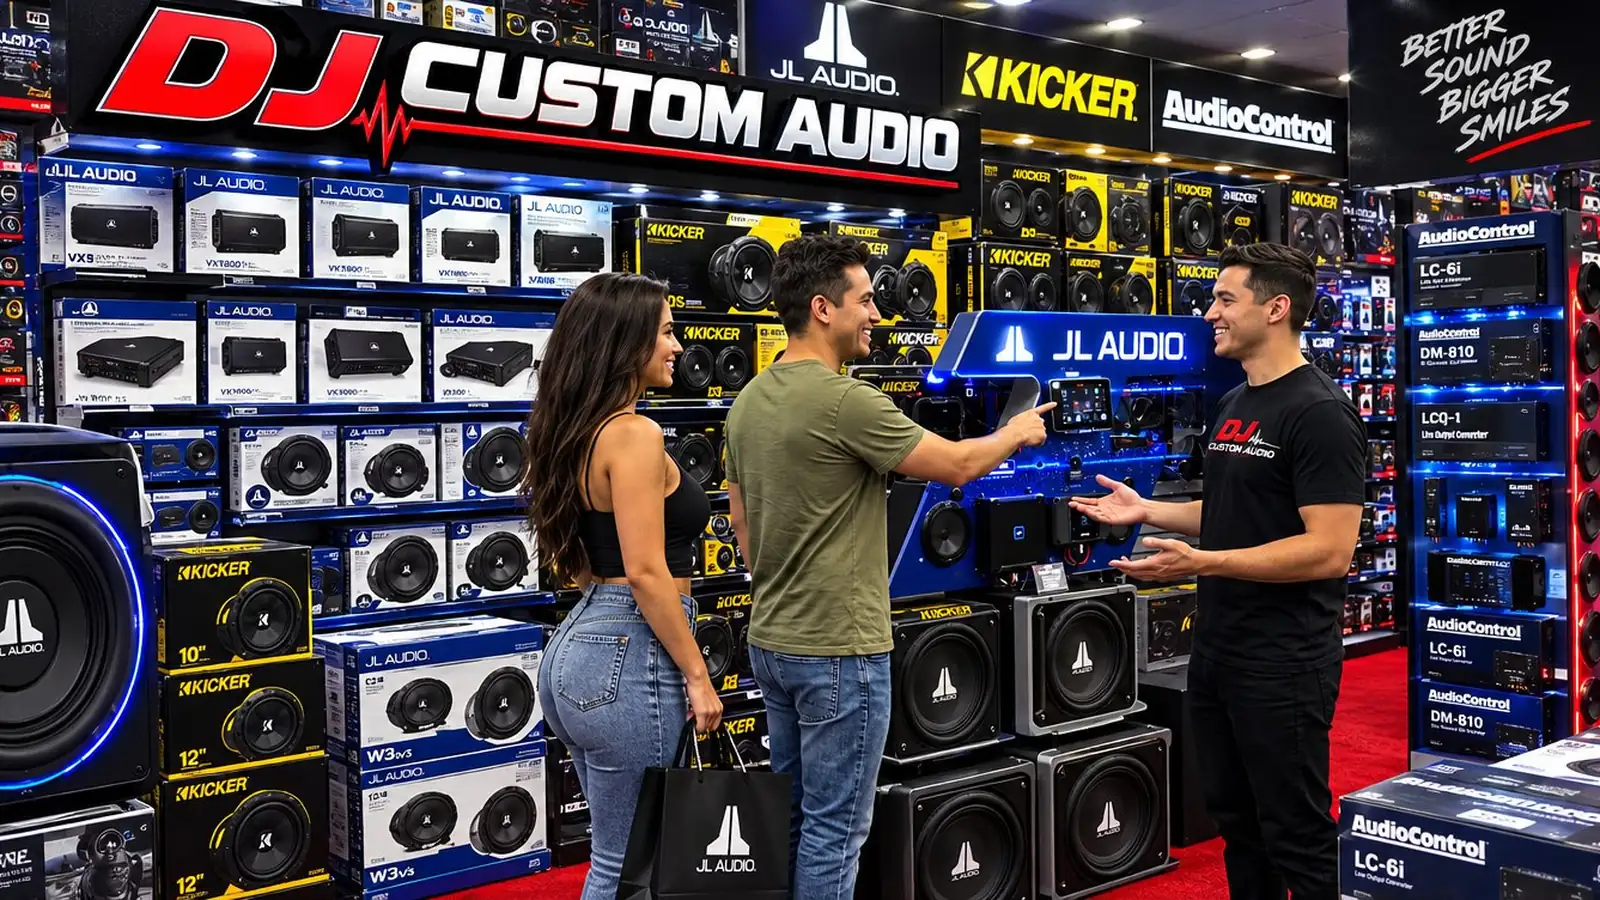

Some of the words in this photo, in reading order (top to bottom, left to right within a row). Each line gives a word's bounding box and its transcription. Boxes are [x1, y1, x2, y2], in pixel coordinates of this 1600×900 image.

[1401, 8, 1507, 67] BETTER
[770, 59, 804, 82] JL
[1420, 33, 1530, 96] SOUND
[96, 7, 383, 131] DJ
[401, 41, 764, 148] CUSTOM
[776, 97, 960, 172] AUDIO
[1437, 59, 1554, 124] BIGGER
[1162, 90, 1333, 146] AudioControl
[1455, 86, 1571, 153] SMILES
[82, 168, 137, 183] AUDIO
[193, 176, 213, 187] JL
[321, 184, 338, 194] JL
[429, 192, 450, 206] JL
[527, 202, 543, 212] JL
[656, 224, 705, 240] KICKER
[1418, 220, 1535, 247] AudioControl
[1001, 250, 1051, 267] KICKER
[1420, 262, 1461, 277] LC-6i
[215, 306, 232, 315] JL
[440, 314, 455, 324] JL
[694, 327, 740, 340] KICKER
[1053, 330, 1092, 360] JL
[1420, 346, 1474, 359] DM-810
[1421, 412, 1461, 426] LCQ-1
[1214, 418, 1260, 441] DJ
[191, 561, 250, 580] KICKER
[1427, 617, 1521, 640] AudioControl
[179, 645, 206, 664] 10"
[1430, 642, 1466, 658] LC-6i
[365, 658, 382, 667] JL
[191, 675, 250, 695] KICKER
[1428, 689, 1511, 711] AudioControl
[1430, 709, 1483, 729] DM-810
[179, 748, 206, 767] 12"
[188, 777, 247, 800] KICKER
[368, 774, 384, 785] JL
[1352, 814, 1486, 861] AudioControl
[696, 859, 713, 872] JL
[1354, 850, 1405, 879] LC-6i
[176, 874, 204, 894] 12"
